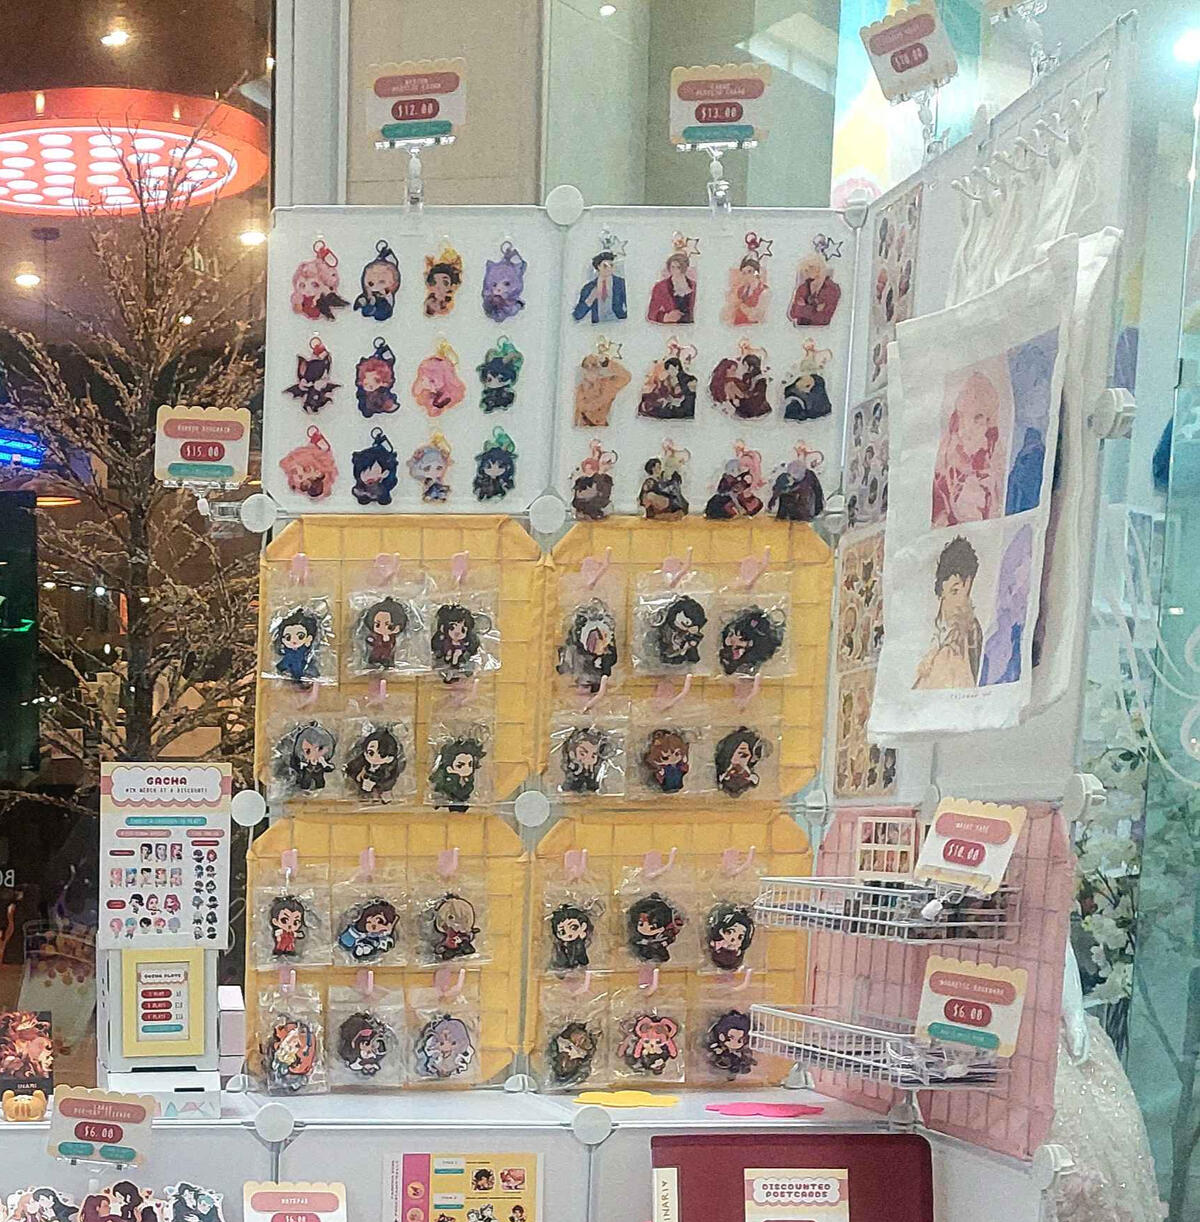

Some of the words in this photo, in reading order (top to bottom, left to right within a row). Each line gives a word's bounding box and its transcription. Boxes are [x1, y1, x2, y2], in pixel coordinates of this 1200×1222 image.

[186, 445, 220, 457] $15.00
[146, 777, 187, 785] GACHA
[953, 1004, 983, 1020] $6.00
[84, 1125, 114, 1139] $6.00
